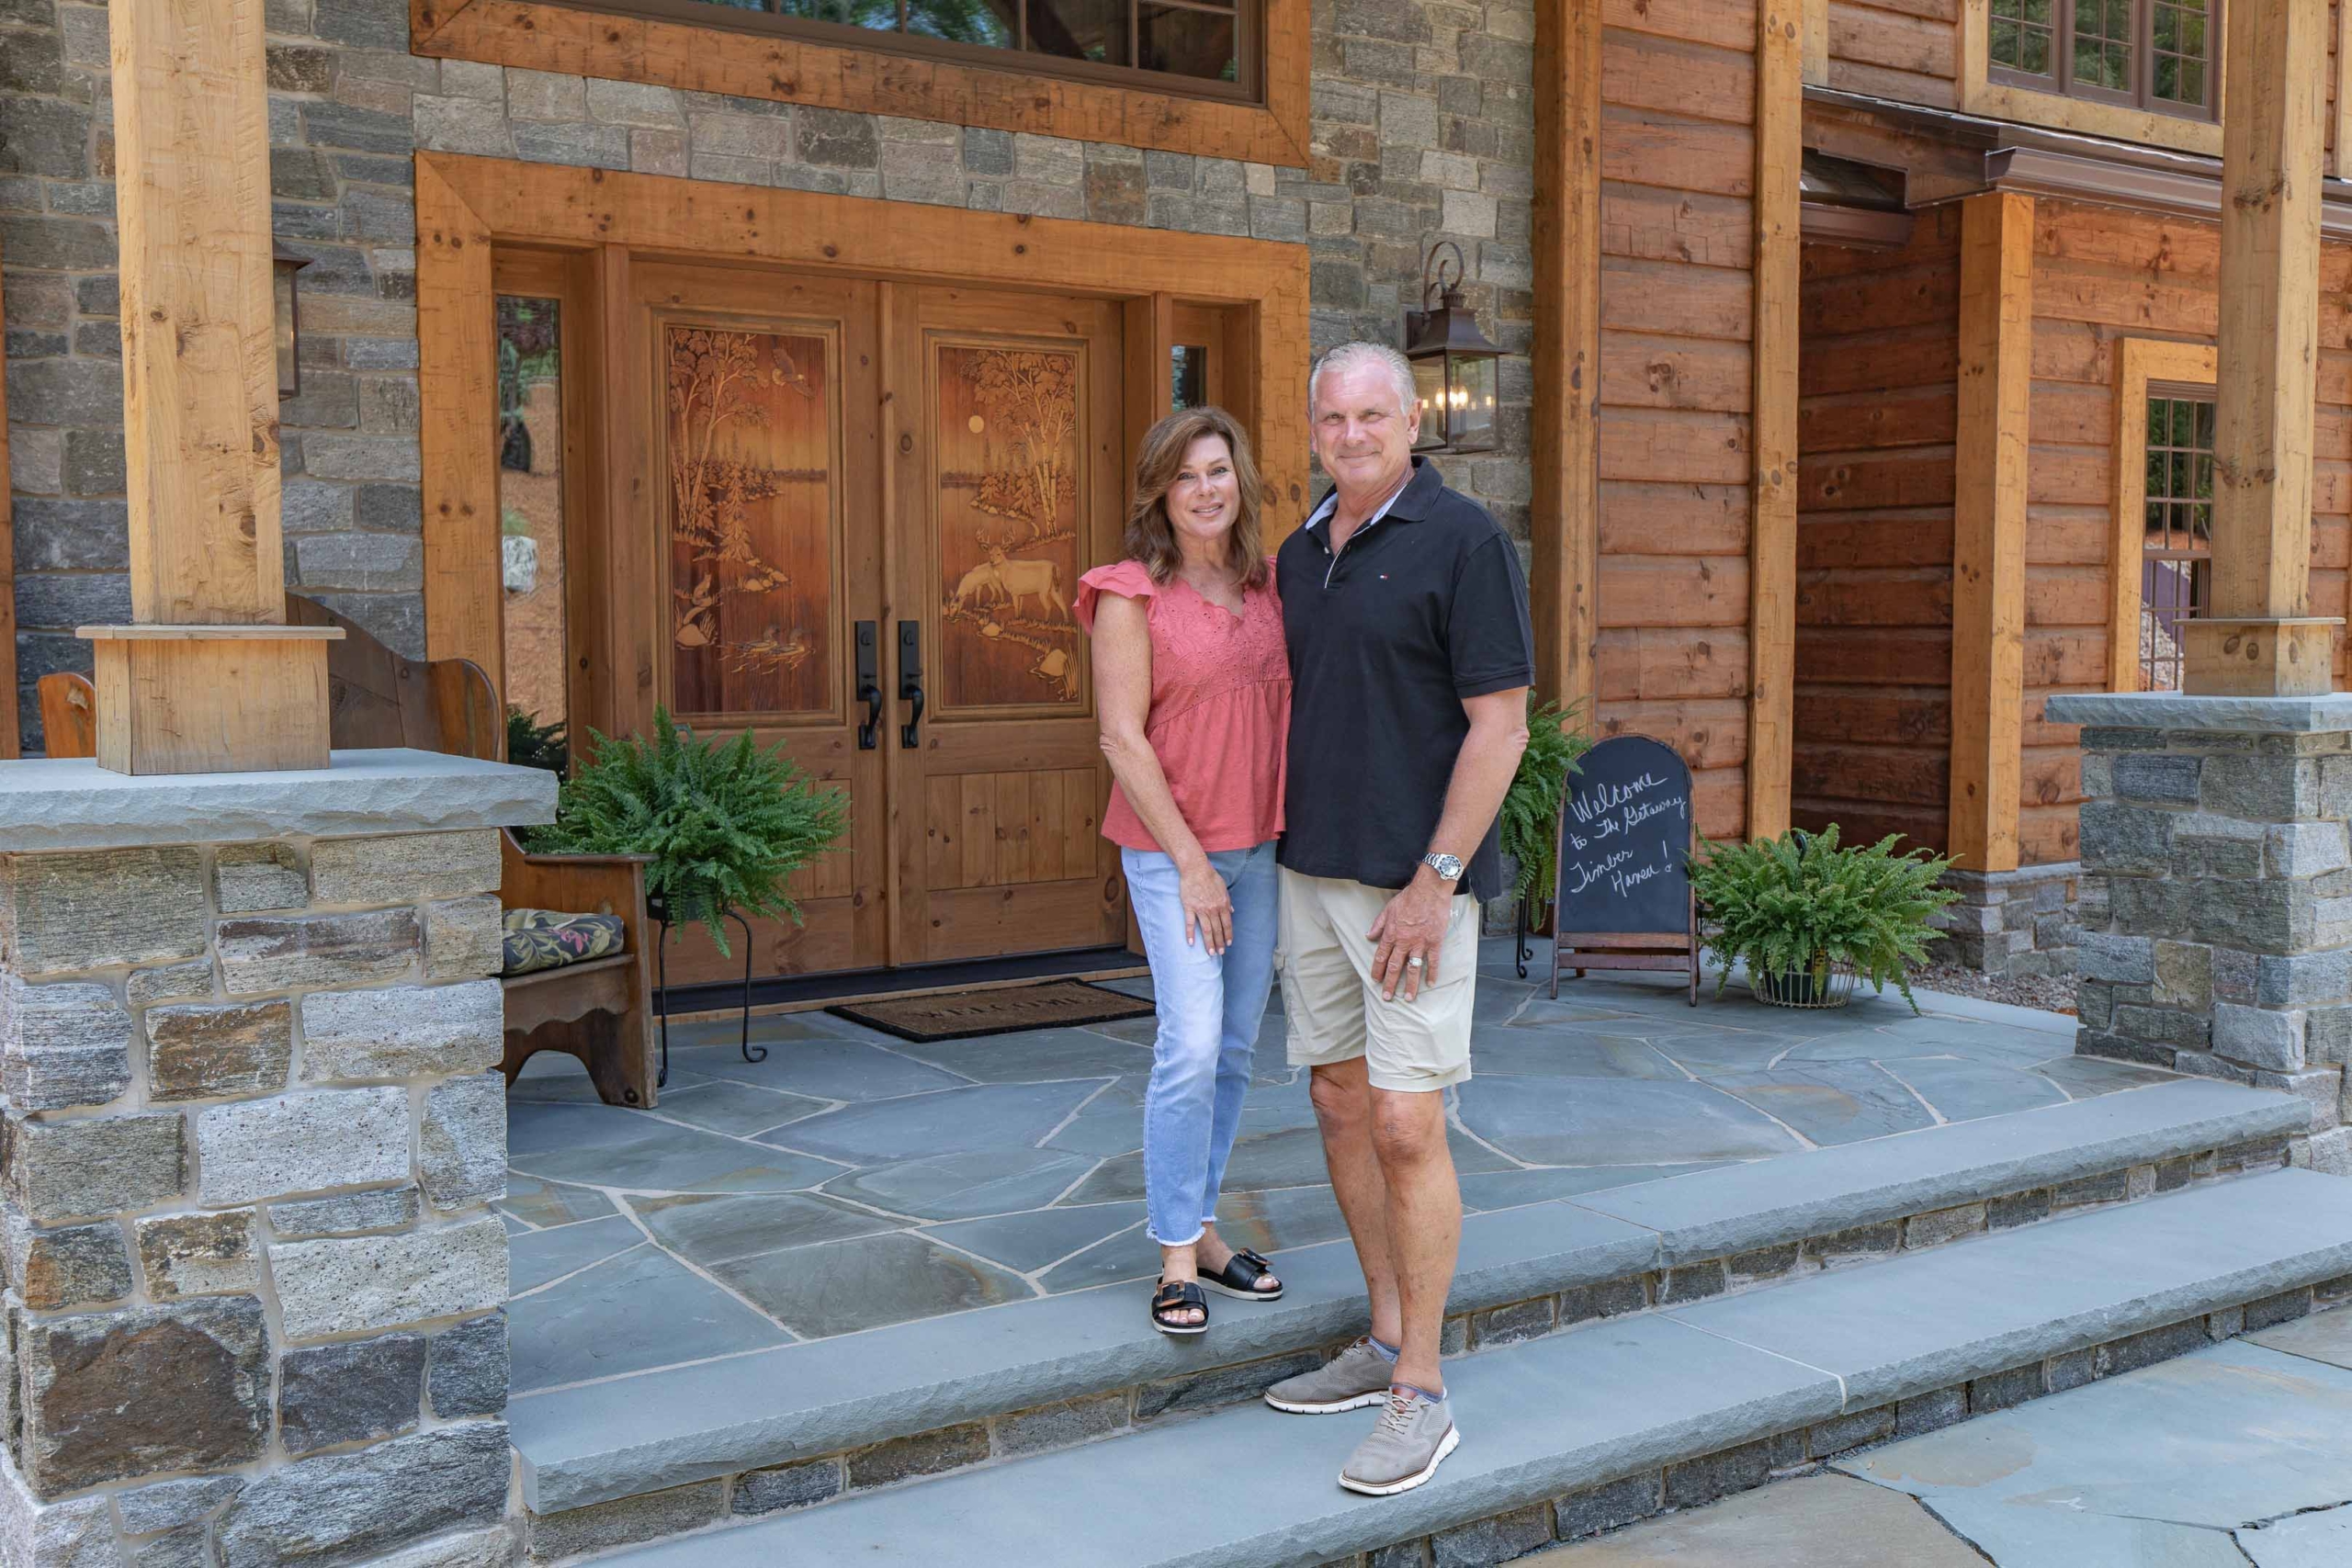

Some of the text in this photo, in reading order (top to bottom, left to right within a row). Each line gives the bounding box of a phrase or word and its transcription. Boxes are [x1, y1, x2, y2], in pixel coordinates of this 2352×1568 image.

[1570, 772, 1669, 823] Welcome
[1570, 796, 1687, 851] to The Getaway
[1569, 850, 1634, 893] Timber
